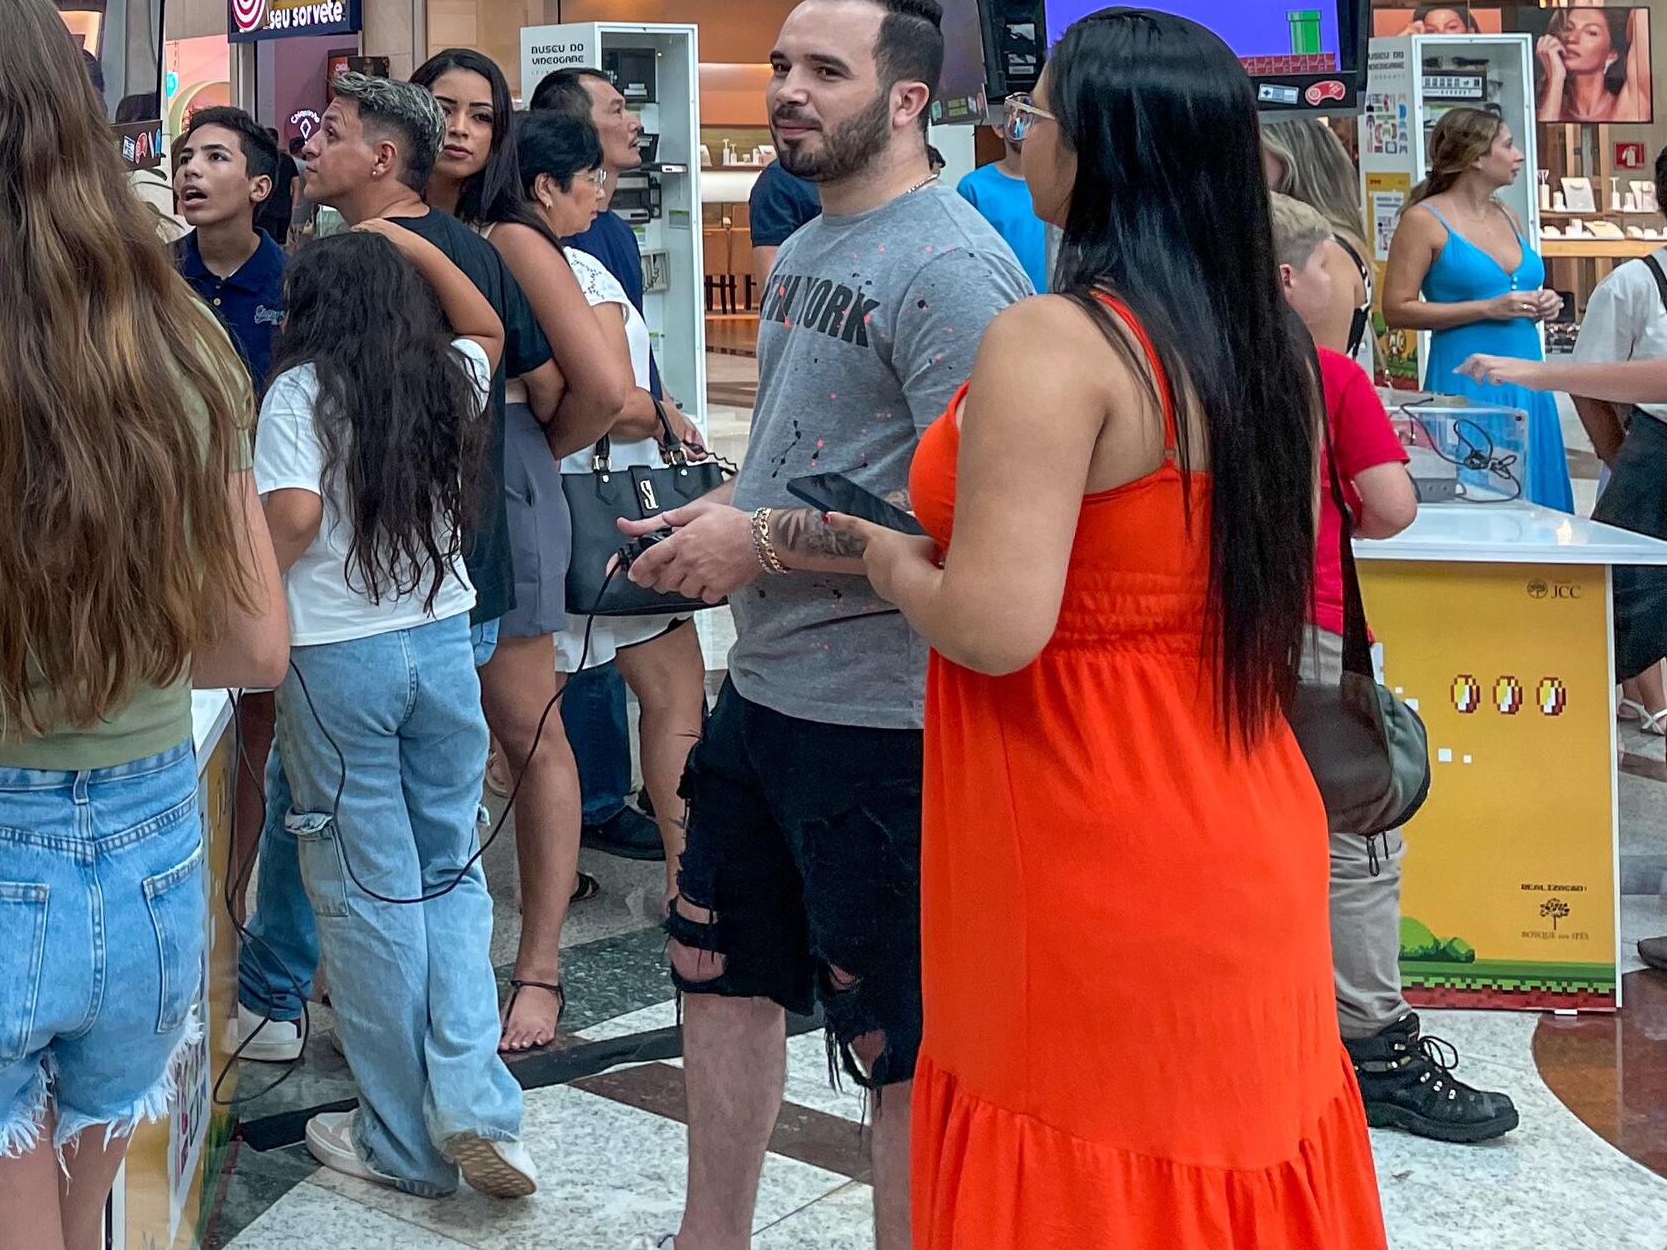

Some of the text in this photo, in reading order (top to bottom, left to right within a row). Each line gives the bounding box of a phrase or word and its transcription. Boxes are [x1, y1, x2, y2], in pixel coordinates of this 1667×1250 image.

[269, 9, 290, 29] seu
[531, 43, 584, 55] MUSEU DO
[796, 275, 881, 348] YORK
[1550, 584, 1582, 599] JCC
